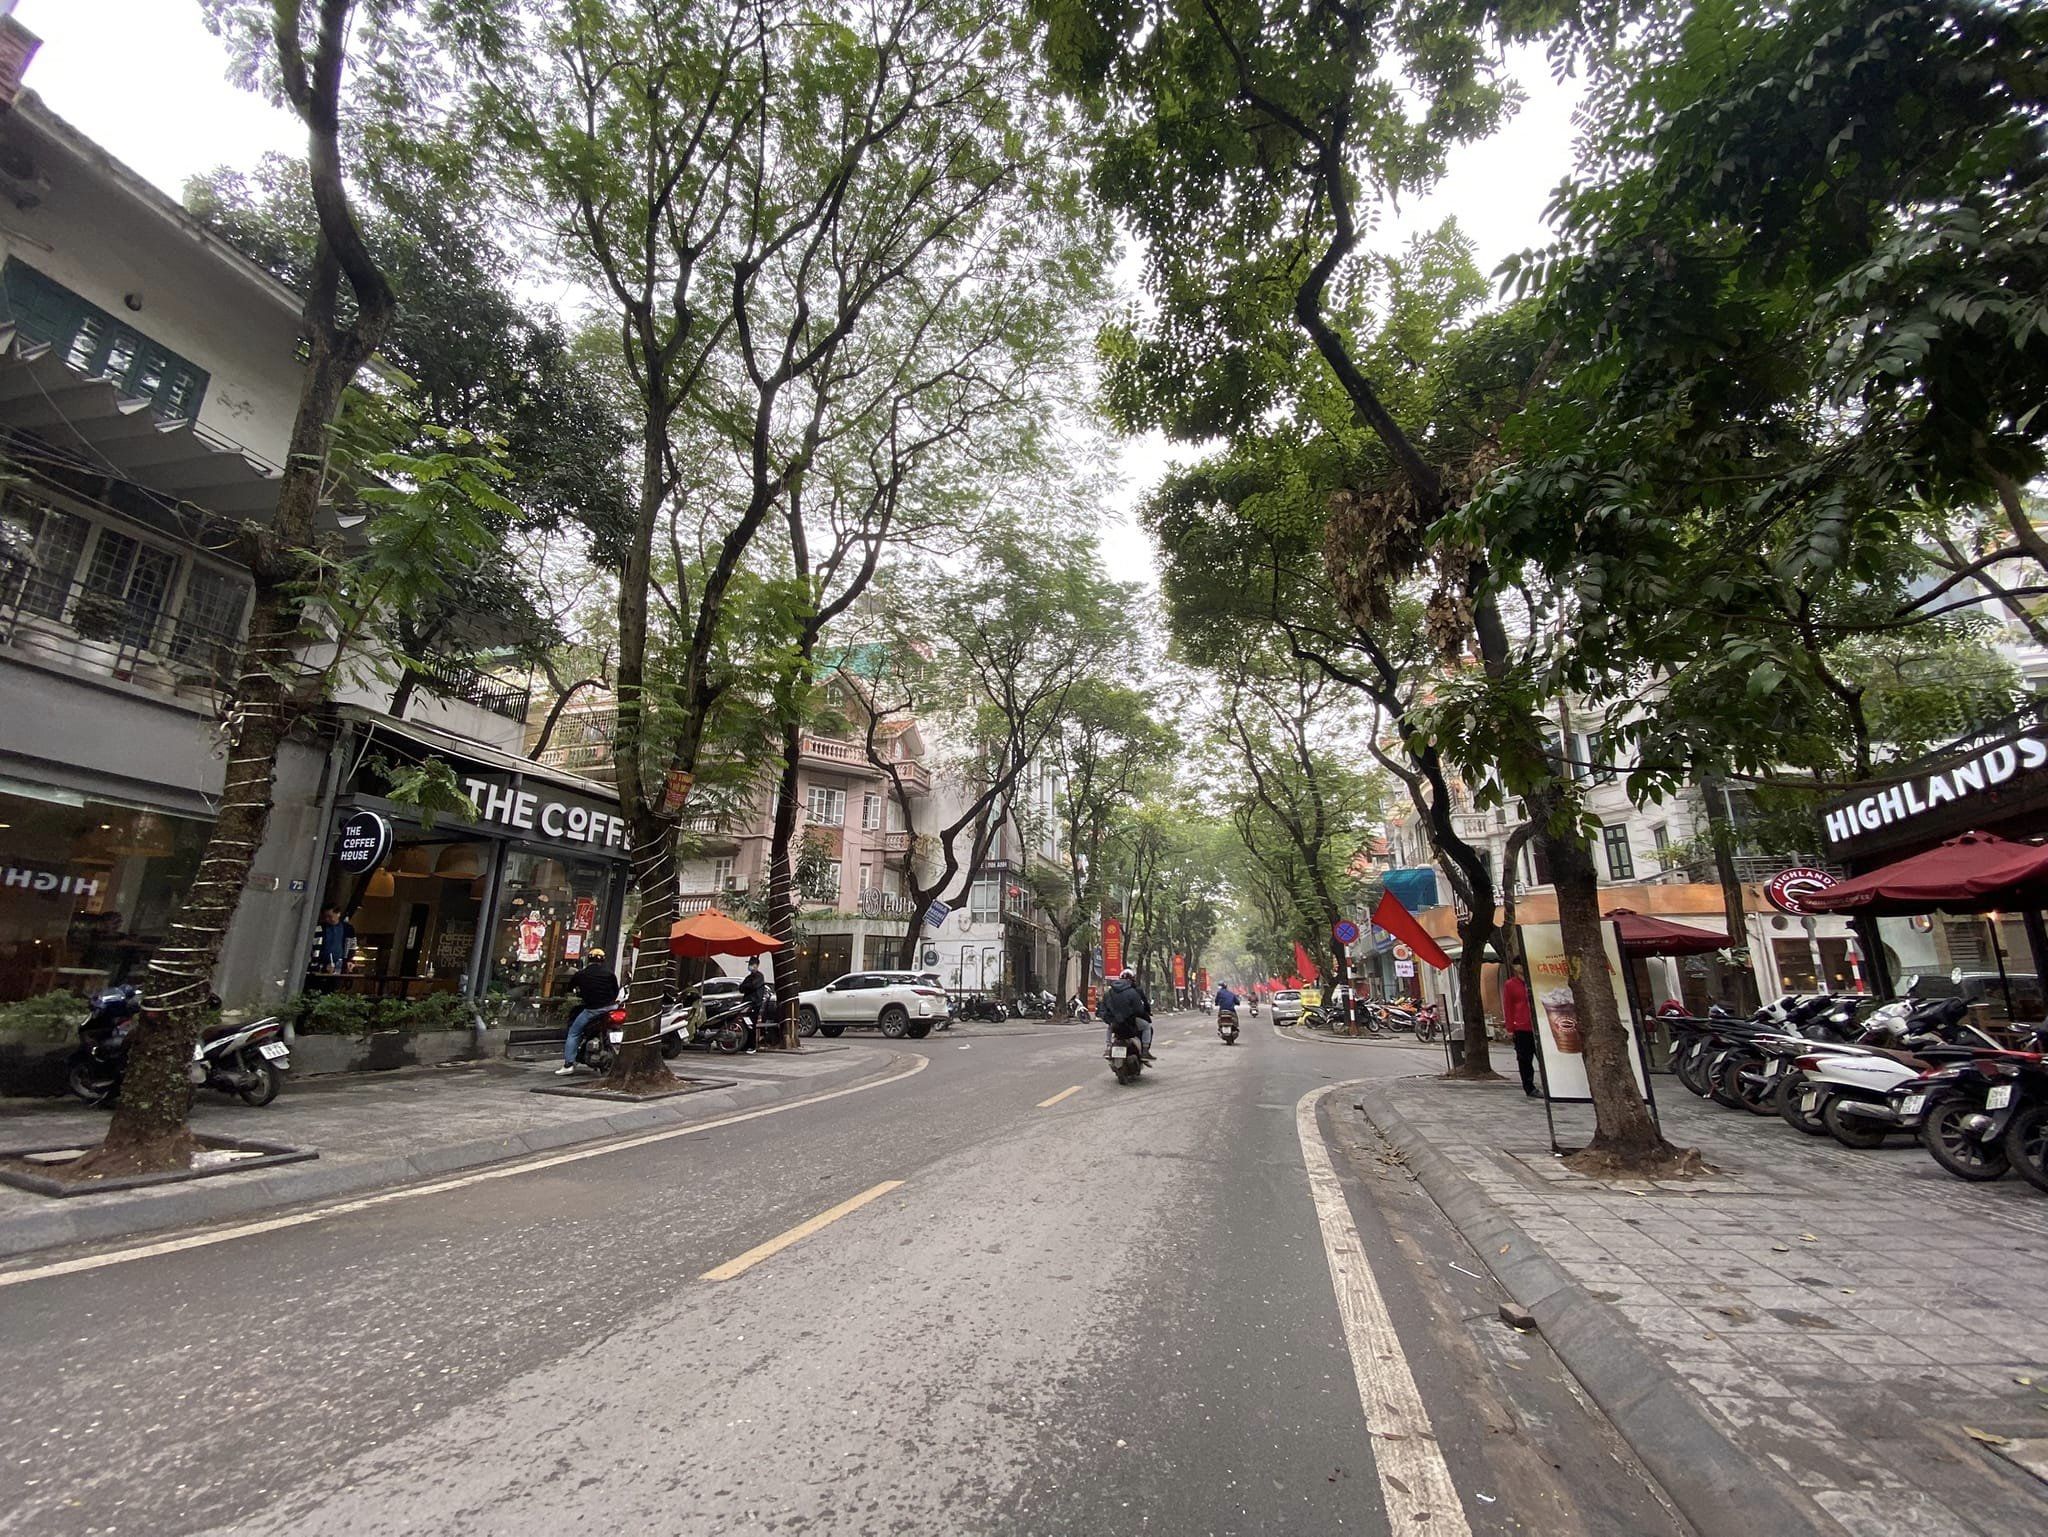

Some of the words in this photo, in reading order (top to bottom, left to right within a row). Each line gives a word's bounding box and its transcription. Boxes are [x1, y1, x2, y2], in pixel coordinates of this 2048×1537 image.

[1825, 737, 2048, 843] HIGHLANDS
[466, 778, 538, 830] THE
[541, 803, 634, 850] COFF
[346, 826, 362, 836] THE
[343, 838, 376, 848] COFFEE
[340, 850, 369, 861] HOUSE
